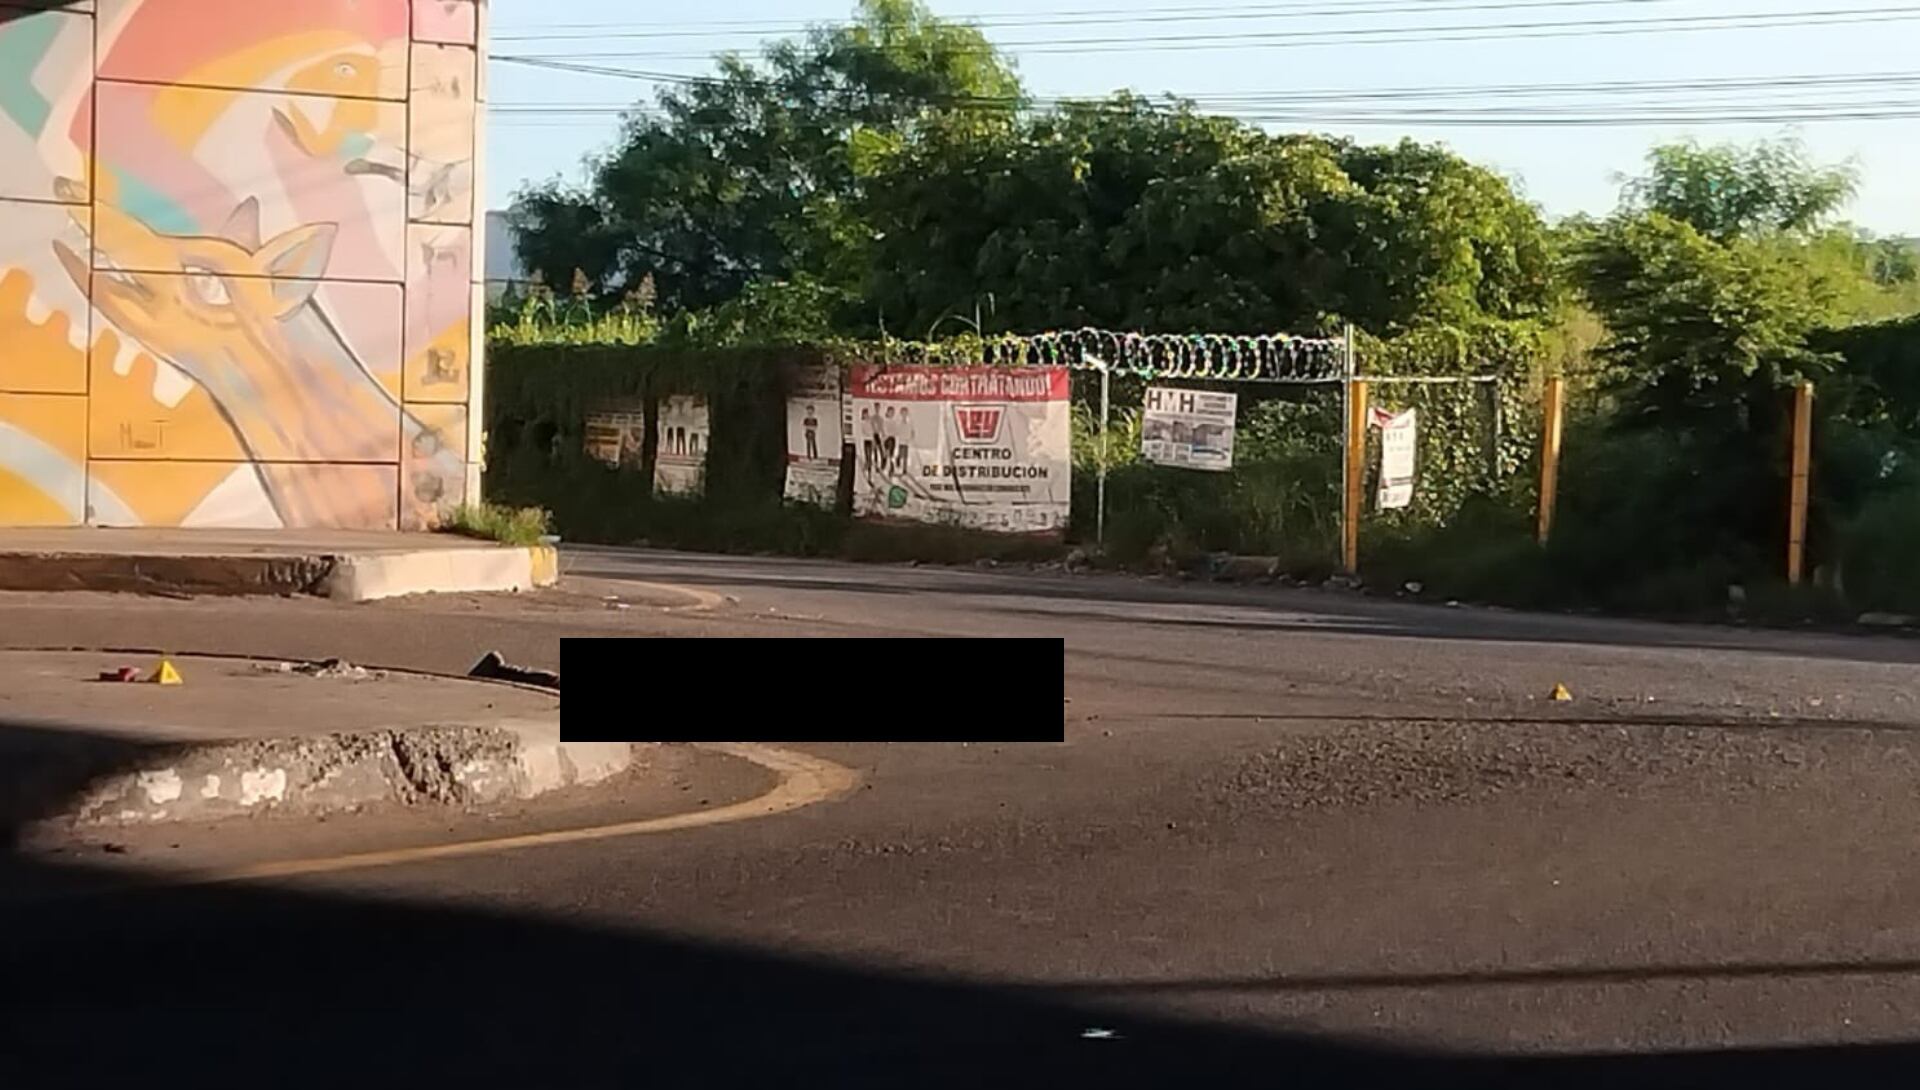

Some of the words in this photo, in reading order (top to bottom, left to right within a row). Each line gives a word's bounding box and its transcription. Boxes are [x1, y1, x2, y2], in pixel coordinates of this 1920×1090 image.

[952, 447, 1012, 460] CENTRO
[922, 465, 939, 478] DE
[943, 464, 1048, 478] DISTRIBUCIÓN
